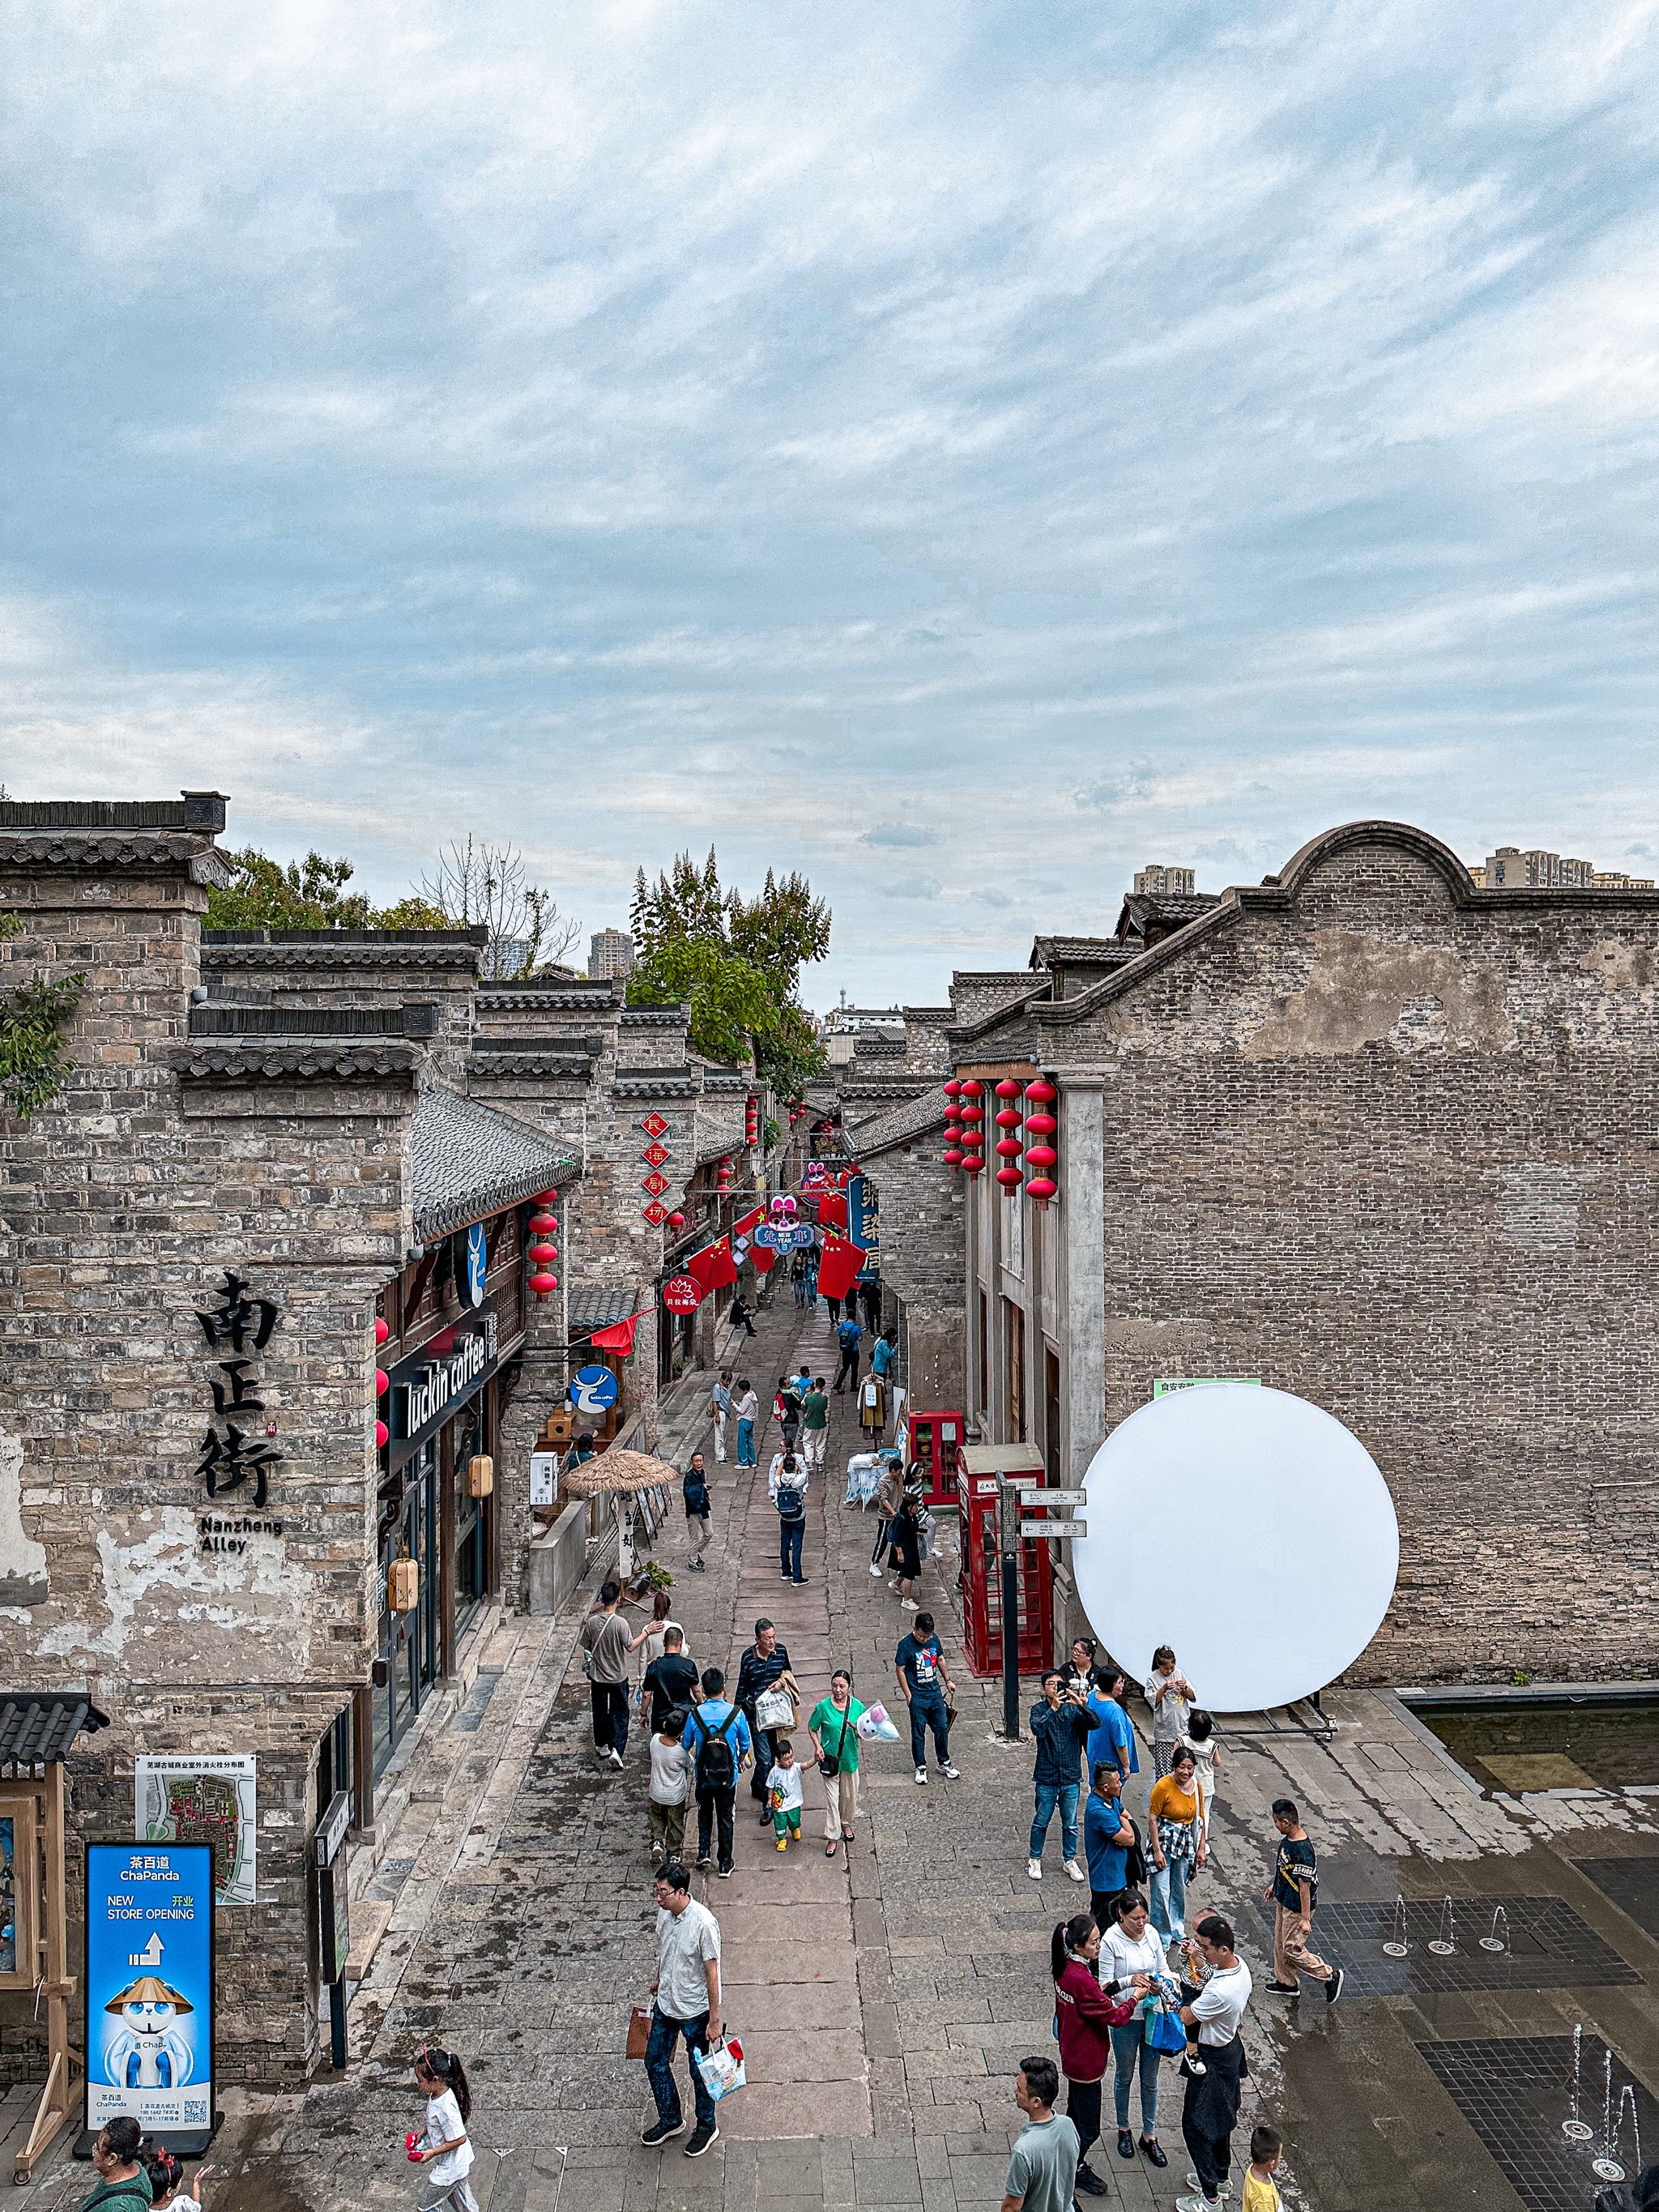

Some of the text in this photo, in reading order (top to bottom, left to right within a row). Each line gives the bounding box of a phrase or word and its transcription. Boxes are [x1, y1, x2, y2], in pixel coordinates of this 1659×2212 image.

[194, 1271, 284, 1509] 南正街
[407, 1333, 484, 1439] luckin coffee
[202, 1517, 282, 1535] Nanzheng
[202, 1536, 246, 1554] Alley
[130, 1855, 170, 1869] 茶百道
[120, 1870, 180, 1881] ChaPanda
[108, 1895, 194, 1907] NEW 开业
[108, 1908, 194, 1919] STORE OPENING
